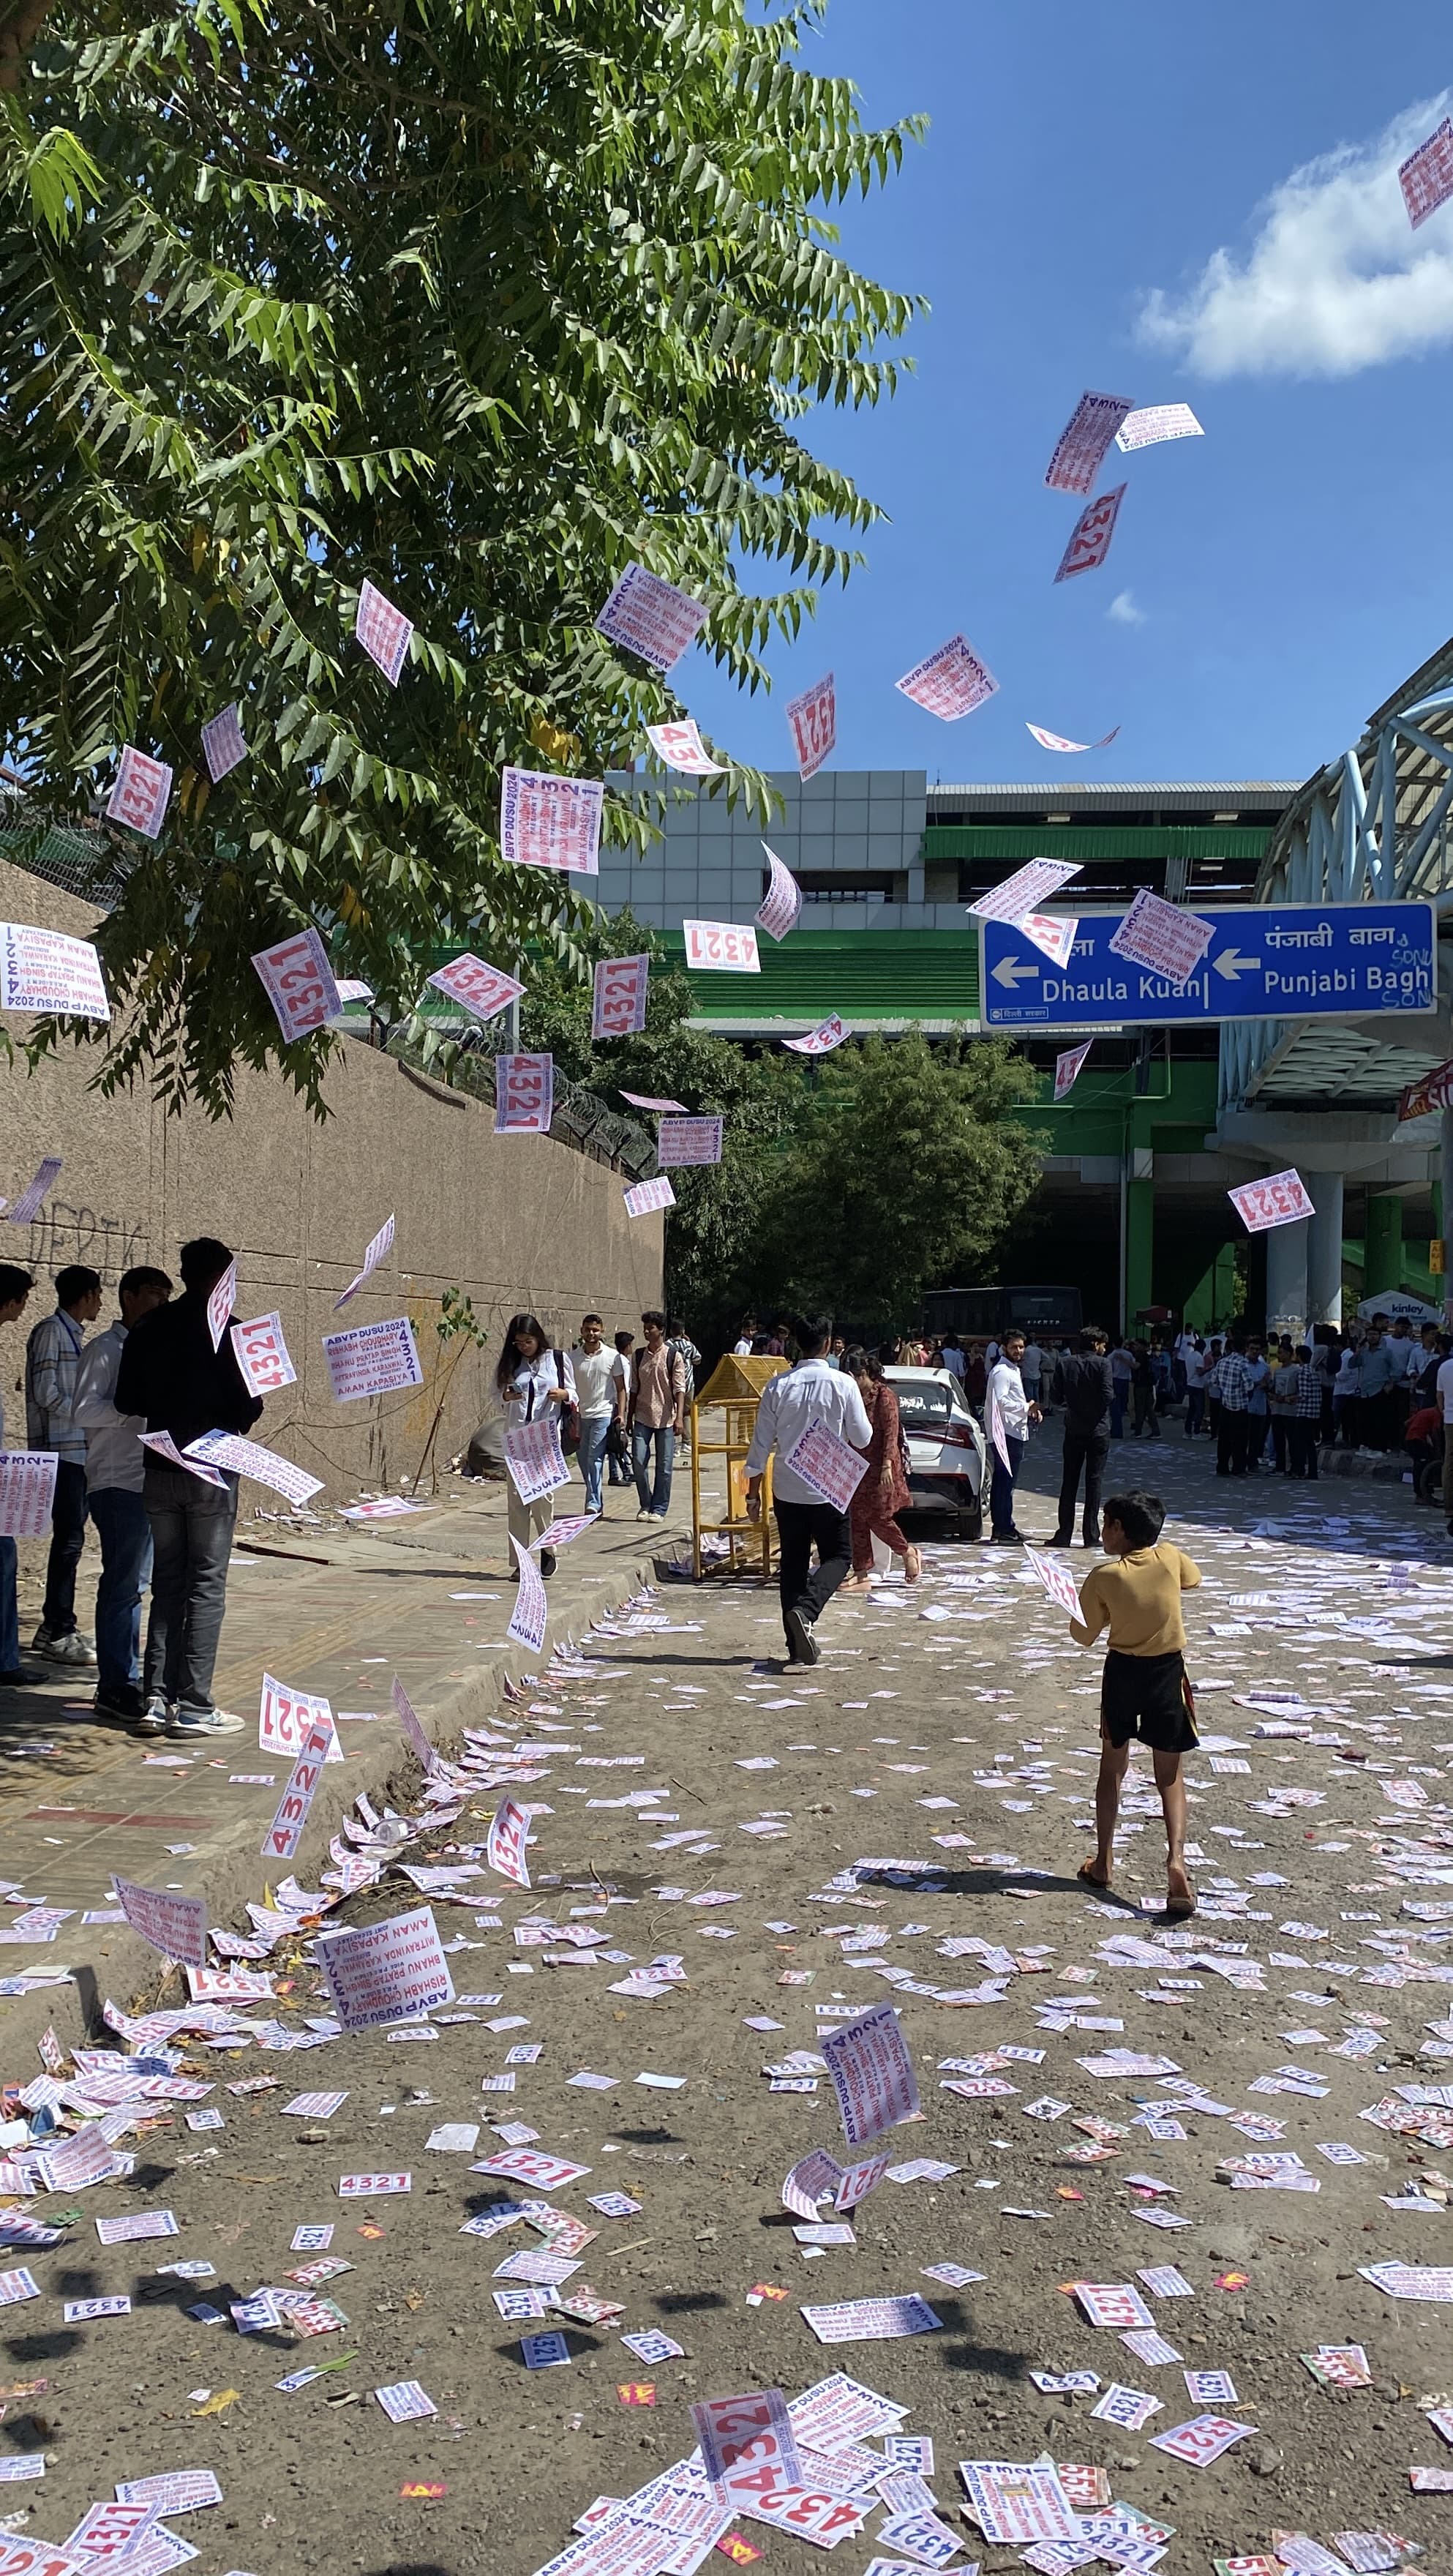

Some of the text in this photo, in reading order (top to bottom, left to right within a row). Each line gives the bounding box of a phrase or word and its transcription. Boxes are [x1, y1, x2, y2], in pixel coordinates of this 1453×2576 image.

[599, 619, 672, 668] ABVP DUSU 2024
[922, 636, 962, 670] DUSU 2024
[504, 773, 517, 858] ABVP DUSU 2024
[16, 933, 93, 959] AMAN KAPASIYA
[1114, 940, 1133, 954] 2024
[1265, 923, 1394, 948] पंजाबी बाग
[19, 967, 45, 977] SINGH
[1132, 951, 1154, 966] DUSU
[1154, 965, 1183, 981] ABVP
[1266, 967, 1429, 997] Punjabi Bagh
[20, 984, 70, 997] CHOUDHARY
[1043, 976, 1201, 1002] Dhaula Kuan
[7, 995, 105, 1015] ABVP DUSU 2024
[1392, 1303, 1424, 1315] kinley
[327, 1320, 405, 1345] ABVP DUSU 2024
[358, 1329, 408, 1348] CHOUDHARY 4
[356, 1343, 410, 1362] PRATAP SINGH 3
[405, 1356, 415, 1369] 2
[337, 1370, 416, 1395] AMAN KAPASIYA 1
[190, 1449, 219, 1462] 2024
[548, 1420, 568, 1479] ABVP DUSU 2024
[787, 1458, 803, 1473] 2024
[802, 1471, 820, 1489] DUSU
[322, 1917, 428, 1959] AMAN KAPASIYA 1
[326, 1936, 434, 1977] MITRAVINDA KARANWAL 2
[332, 1954, 440, 1996] BHANU PRATAP SINGH 3
[338, 1974, 446, 2016] RISHABH CHOUDHARY 4
[343, 1989, 447, 2028] ABVP DUSU 2024
[869, 2033, 887, 2073] KARANWAL
[883, 2022, 912, 2110] AMAN KAPASIYA
[853, 2040, 876, 2098] PRATAP SINGH
[822, 2042, 857, 2143] ABVP DUSU 2024
[838, 2049, 868, 2139] RISHABH CHOUDHARY
[809, 2304, 850, 2312] ABVP
[797, 2375, 846, 2405] DUSU 2024
[806, 2386, 850, 2412] CHOUDHARY
[819, 2411, 888, 2449] AMAN KAPASIYA
[866, 2453, 896, 2466] 2024
[653, 2483, 670, 2501] 2024
[964, 2464, 998, 2537] ABVP DUSU 2024
[1037, 2476, 1058, 2512] KAPASIYA
[759, 2487, 860, 2532] 432
[585, 2524, 630, 2557] CHOUDHARY
[1081, 2521, 1128, 2536] 321
[541, 2550, 576, 2576] ABVP
[576, 2529, 607, 2550] DUSU
[604, 2512, 631, 2531] 2024
[633, 2539, 680, 2576] KAPASIYA
[675, 2543, 699, 2570] AMAN
